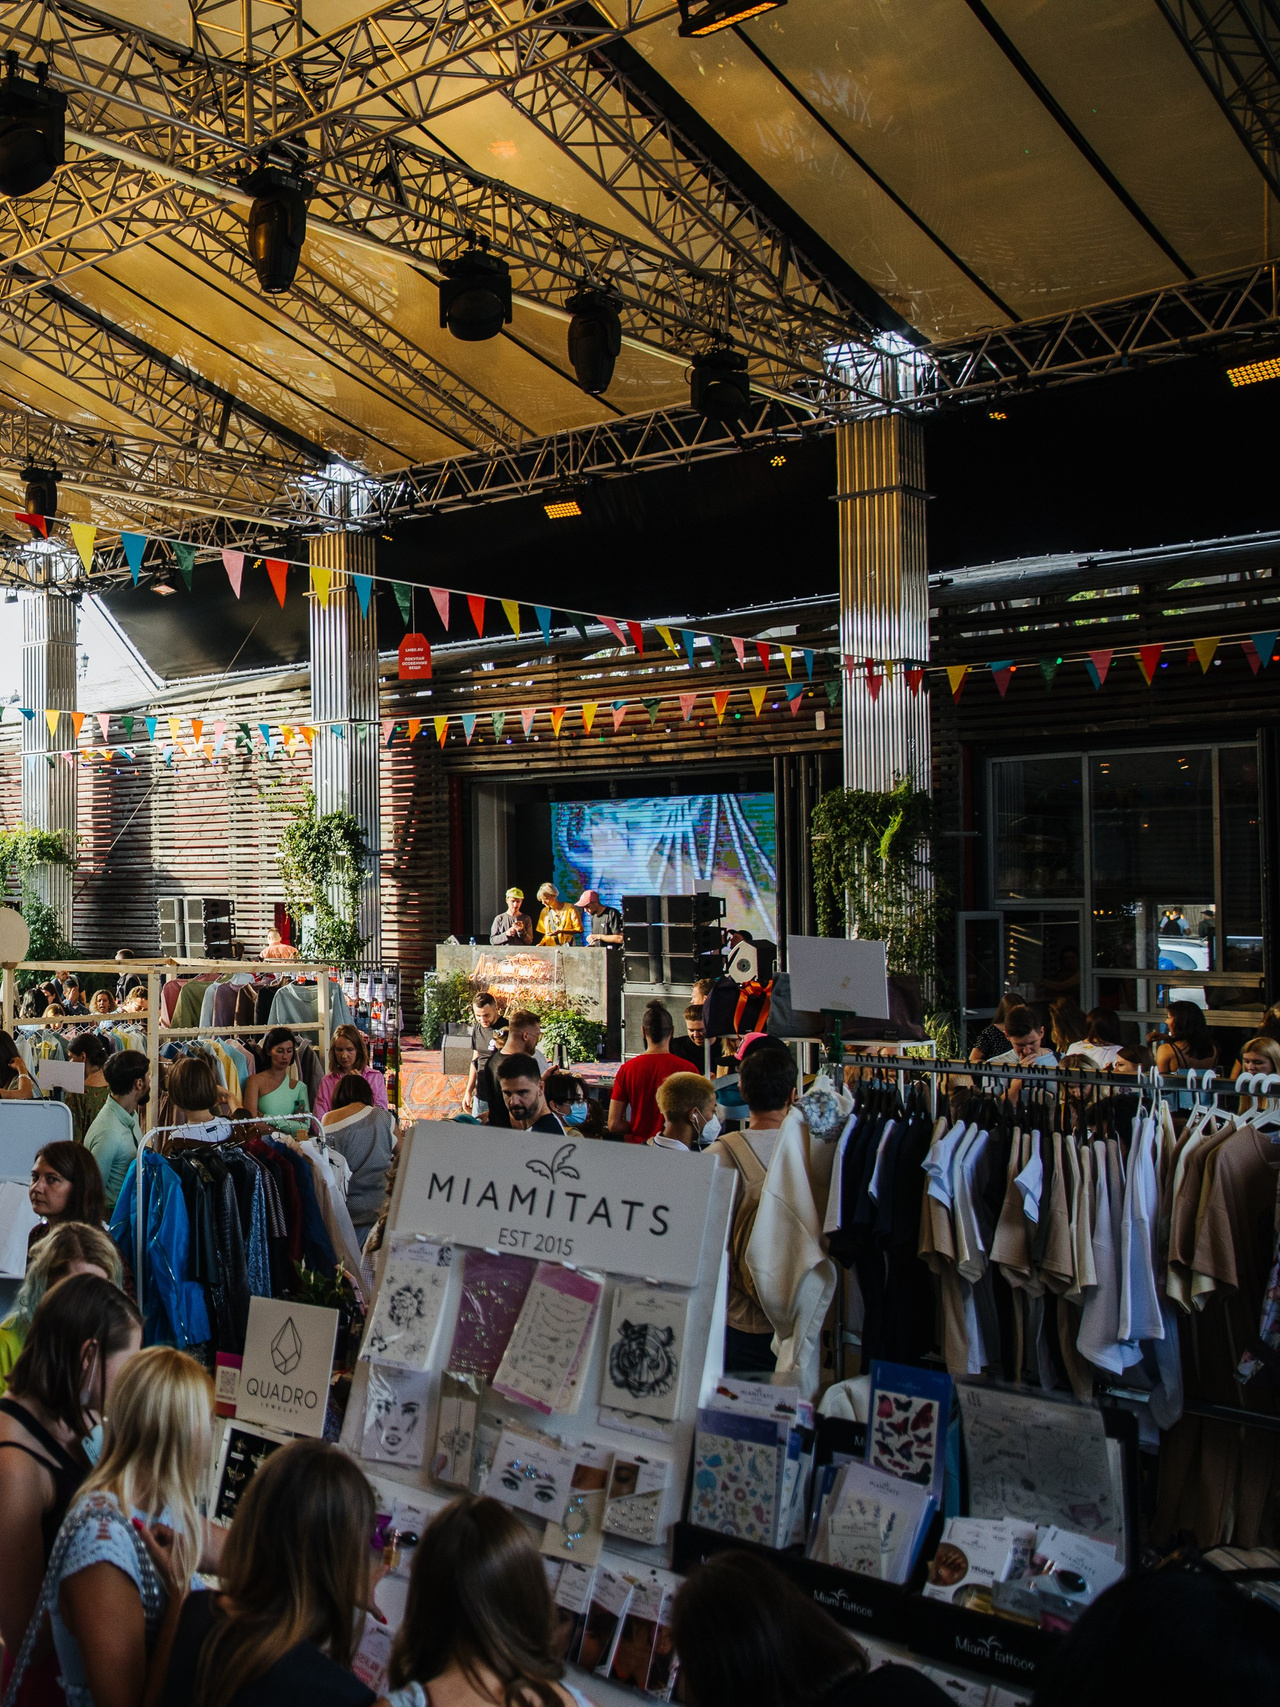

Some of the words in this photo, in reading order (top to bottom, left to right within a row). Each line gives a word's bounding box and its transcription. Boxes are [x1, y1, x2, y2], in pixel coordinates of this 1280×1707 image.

[427, 1172, 670, 1236] MIAMITATS
[497, 1227, 532, 1246] EST
[533, 1233, 574, 1257] 2015
[246, 1378, 318, 1409] QUADRO
[970, 1565, 995, 1576] VELOUR
[813, 1589, 840, 1608] Miami
[955, 1635, 990, 1658] Miami
